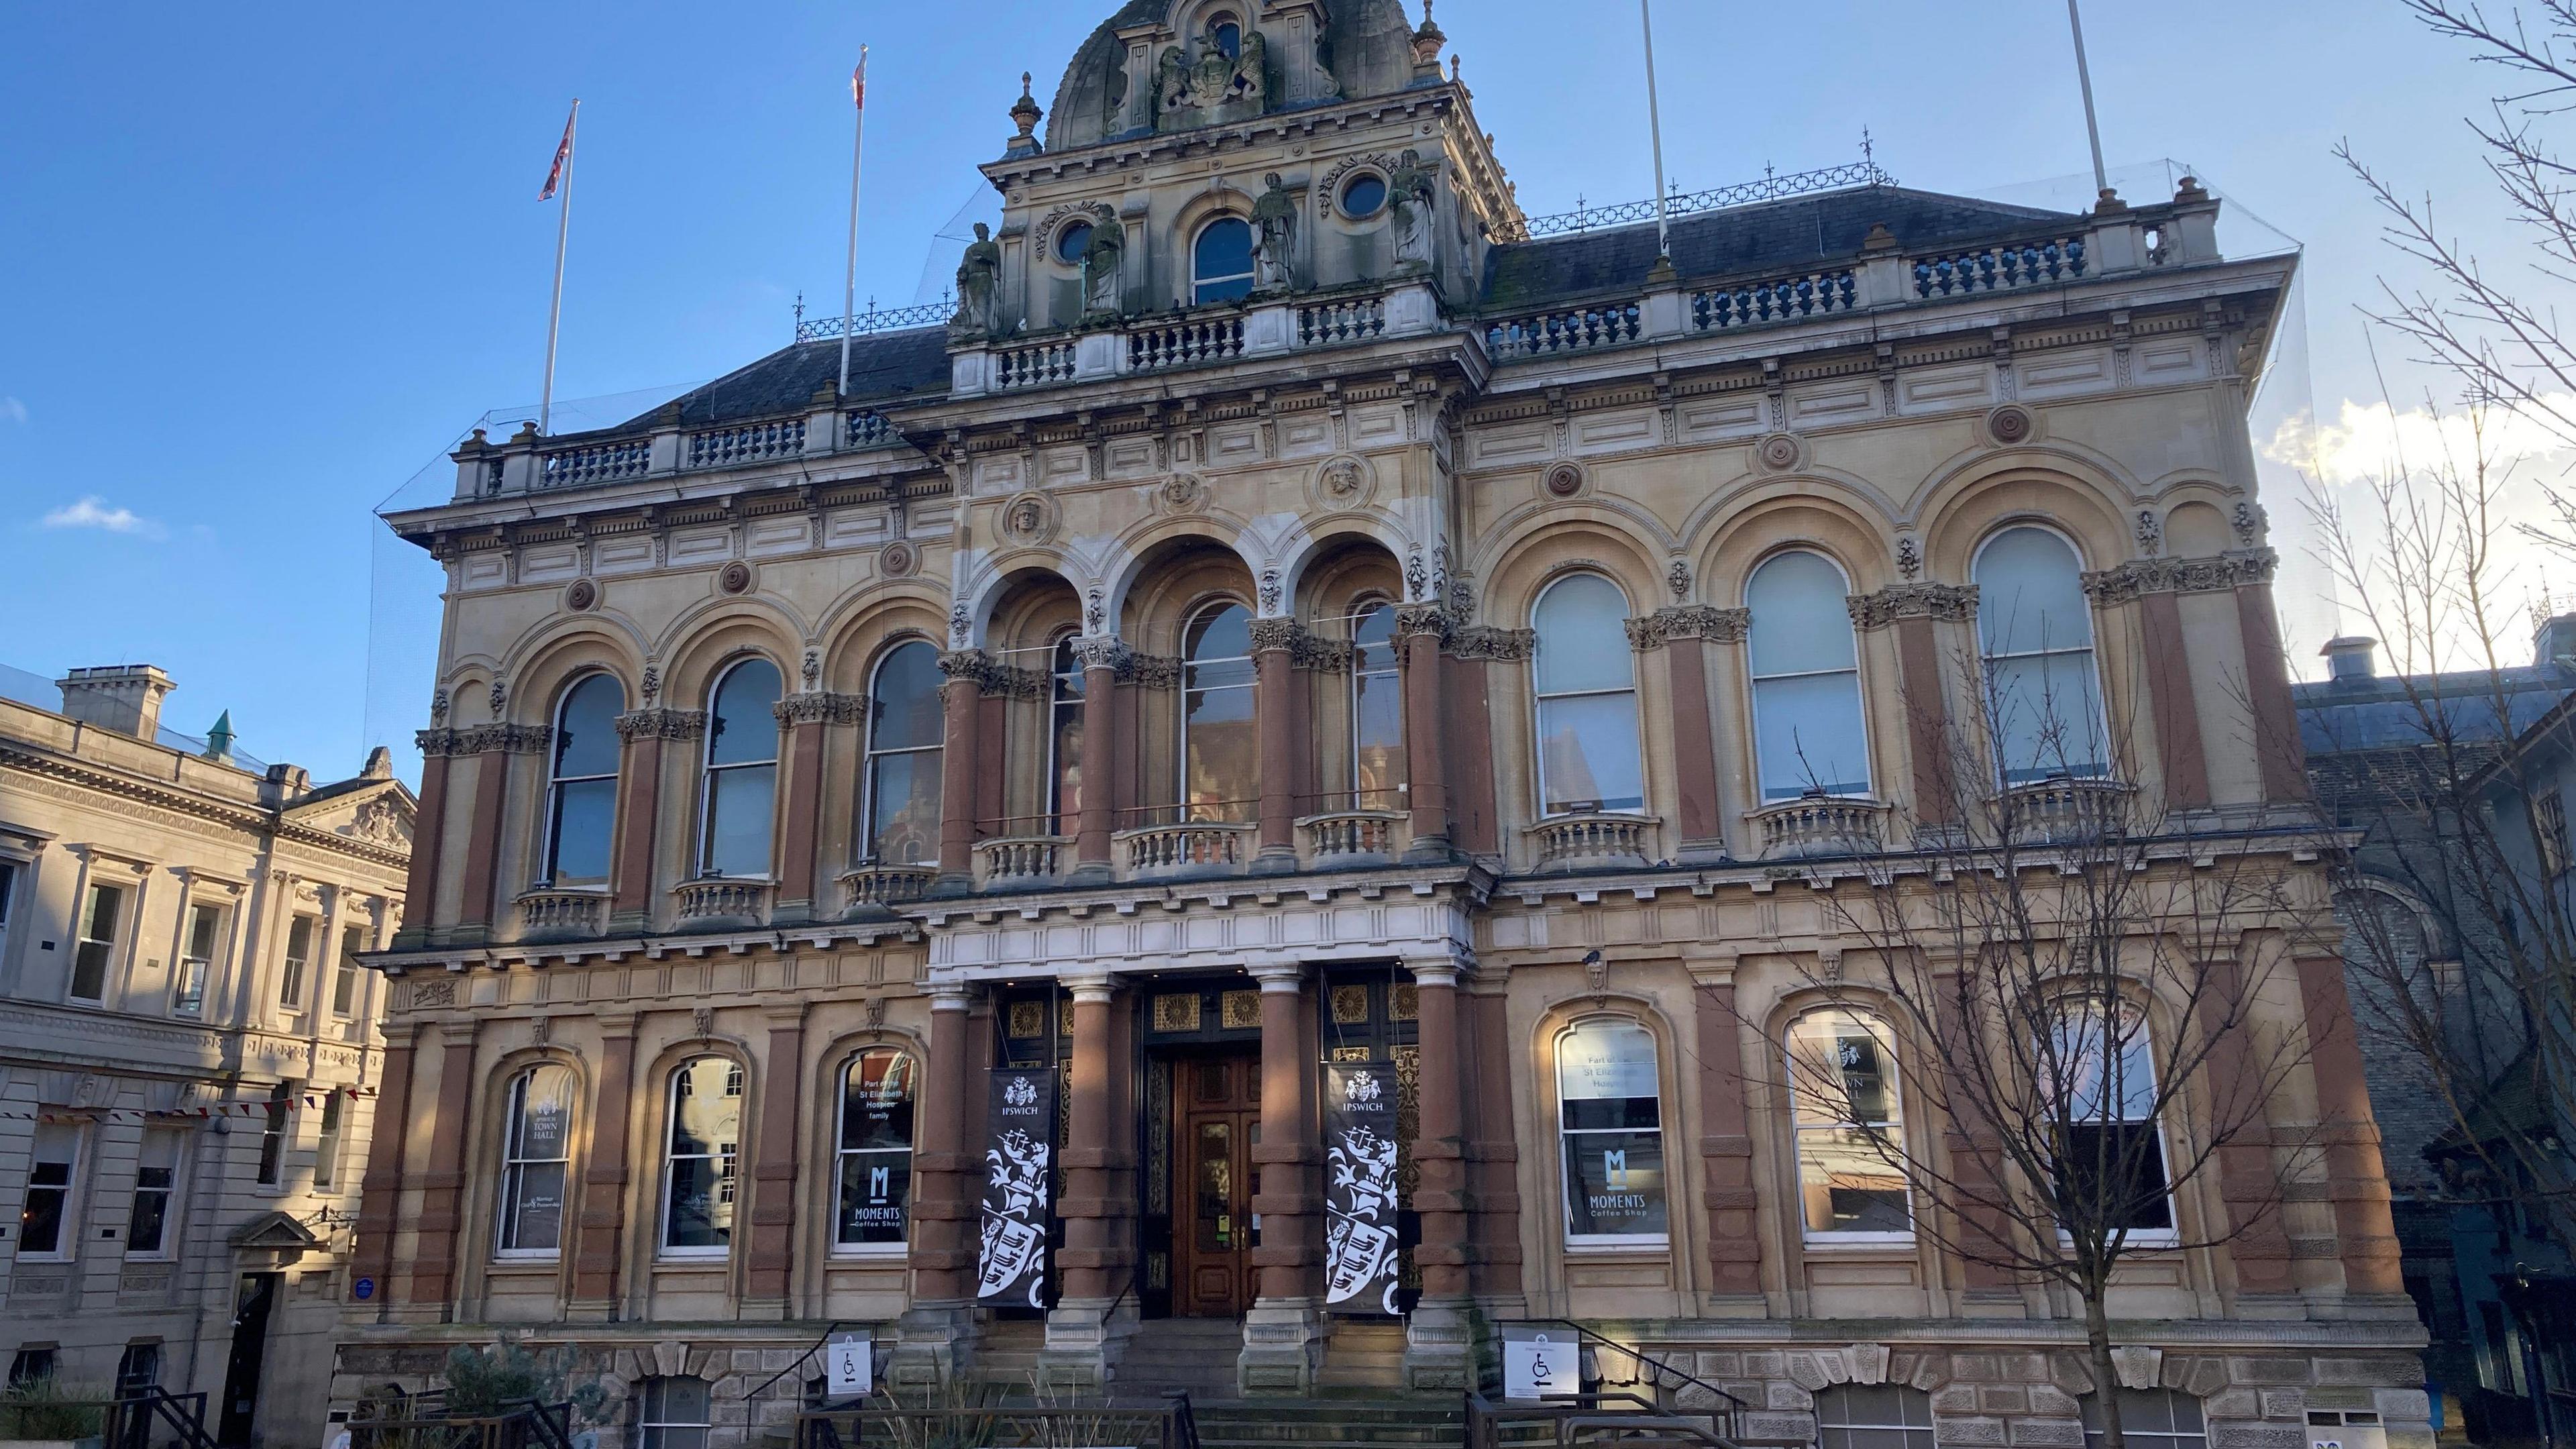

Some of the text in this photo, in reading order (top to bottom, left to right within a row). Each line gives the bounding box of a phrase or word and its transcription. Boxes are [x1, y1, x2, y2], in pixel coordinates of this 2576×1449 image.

[1002, 1107, 1038, 1116] IPSWICH
[1343, 1103, 1383, 1112] IPSWICH
[869, 1112, 889, 1120] family
[534, 1122, 557, 1130] TOWN
[533, 1131, 555, 1139] HALL
[1605, 1150, 1627, 1183] M
[871, 1167, 889, 1197] M
[1589, 1194, 1646, 1209] MOMENTS
[855, 1208, 900, 1220] MOMENTS
